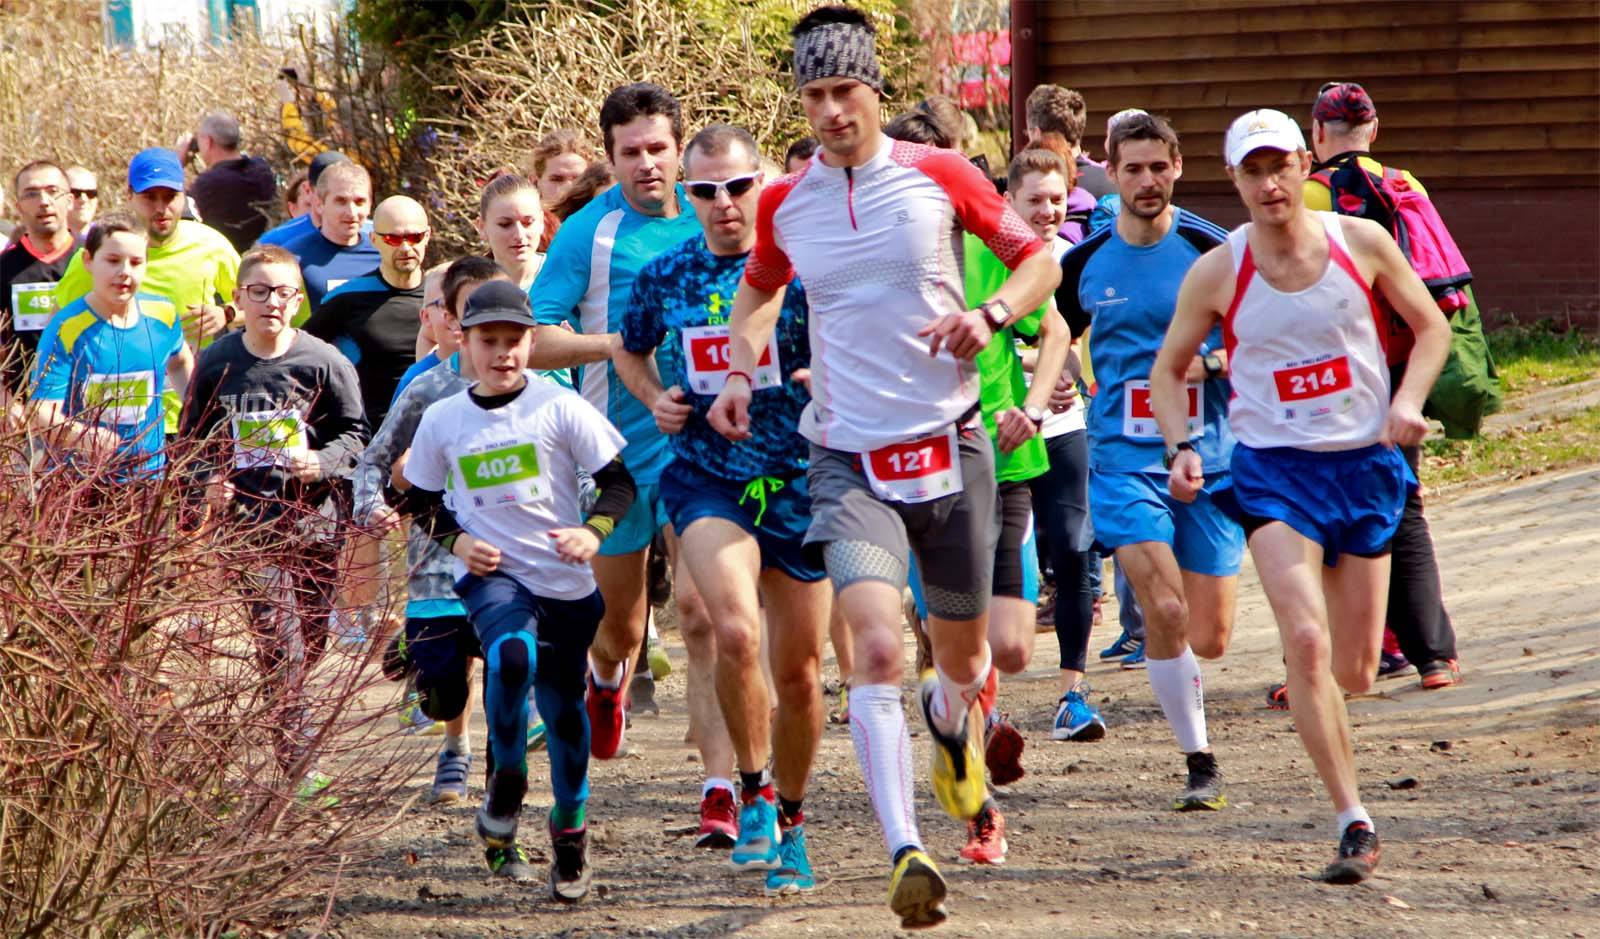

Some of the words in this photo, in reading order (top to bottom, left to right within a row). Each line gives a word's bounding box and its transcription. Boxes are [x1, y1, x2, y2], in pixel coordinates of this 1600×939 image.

[705, 344, 730, 365] 10
[1289, 367, 1337, 394] 214
[476, 454, 523, 479] 402
[887, 446, 933, 472] 127
